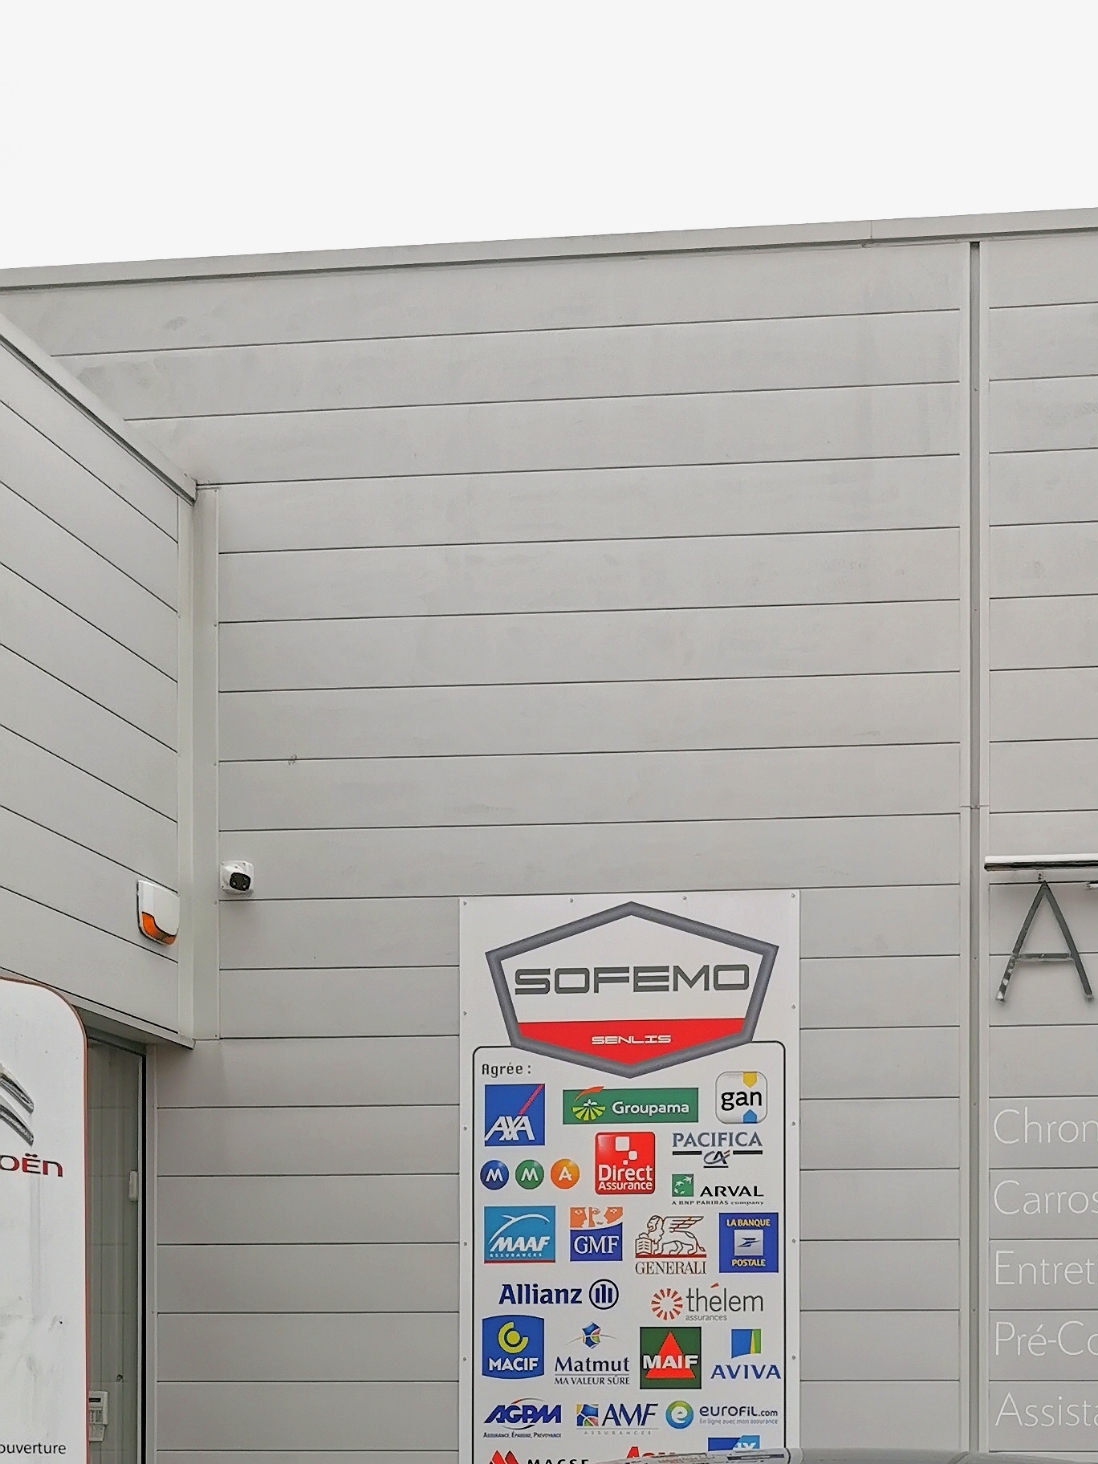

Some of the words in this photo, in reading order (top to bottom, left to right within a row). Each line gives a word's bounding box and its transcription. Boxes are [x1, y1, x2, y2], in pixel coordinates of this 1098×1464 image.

[514, 964, 750, 995] SOFEMO
[591, 1034, 672, 1045] SENLIS
[720, 1088, 763, 1110] gan
[612, 1101, 690, 1116] Groupama
[484, 1115, 536, 1141] AXA
[672, 1131, 763, 1147] PACIFICA
[598, 1164, 653, 1181] Direct
[598, 1181, 653, 1191] Assurance
[700, 1185, 765, 1197] ARVAL
[726, 1219, 738, 1227] LA
[737, 1218, 771, 1227] BANQUE
[489, 1236, 551, 1252] MAAF
[574, 1235, 620, 1254] GMF
[635, 1261, 707, 1275] GENERALI
[731, 1258, 766, 1267] POSTALE
[498, 1283, 583, 1305] Allianz
[488, 1357, 539, 1371] MACIF
[554, 1356, 630, 1372] Matmut
[642, 1354, 699, 1369] MAIF
[710, 1364, 782, 1379] AVIVA
[554, 1377, 570, 1385] MA
[570, 1377, 605, 1385] VALEUR
[483, 1404, 562, 1424] AGPM
[602, 1403, 659, 1426] AMF
